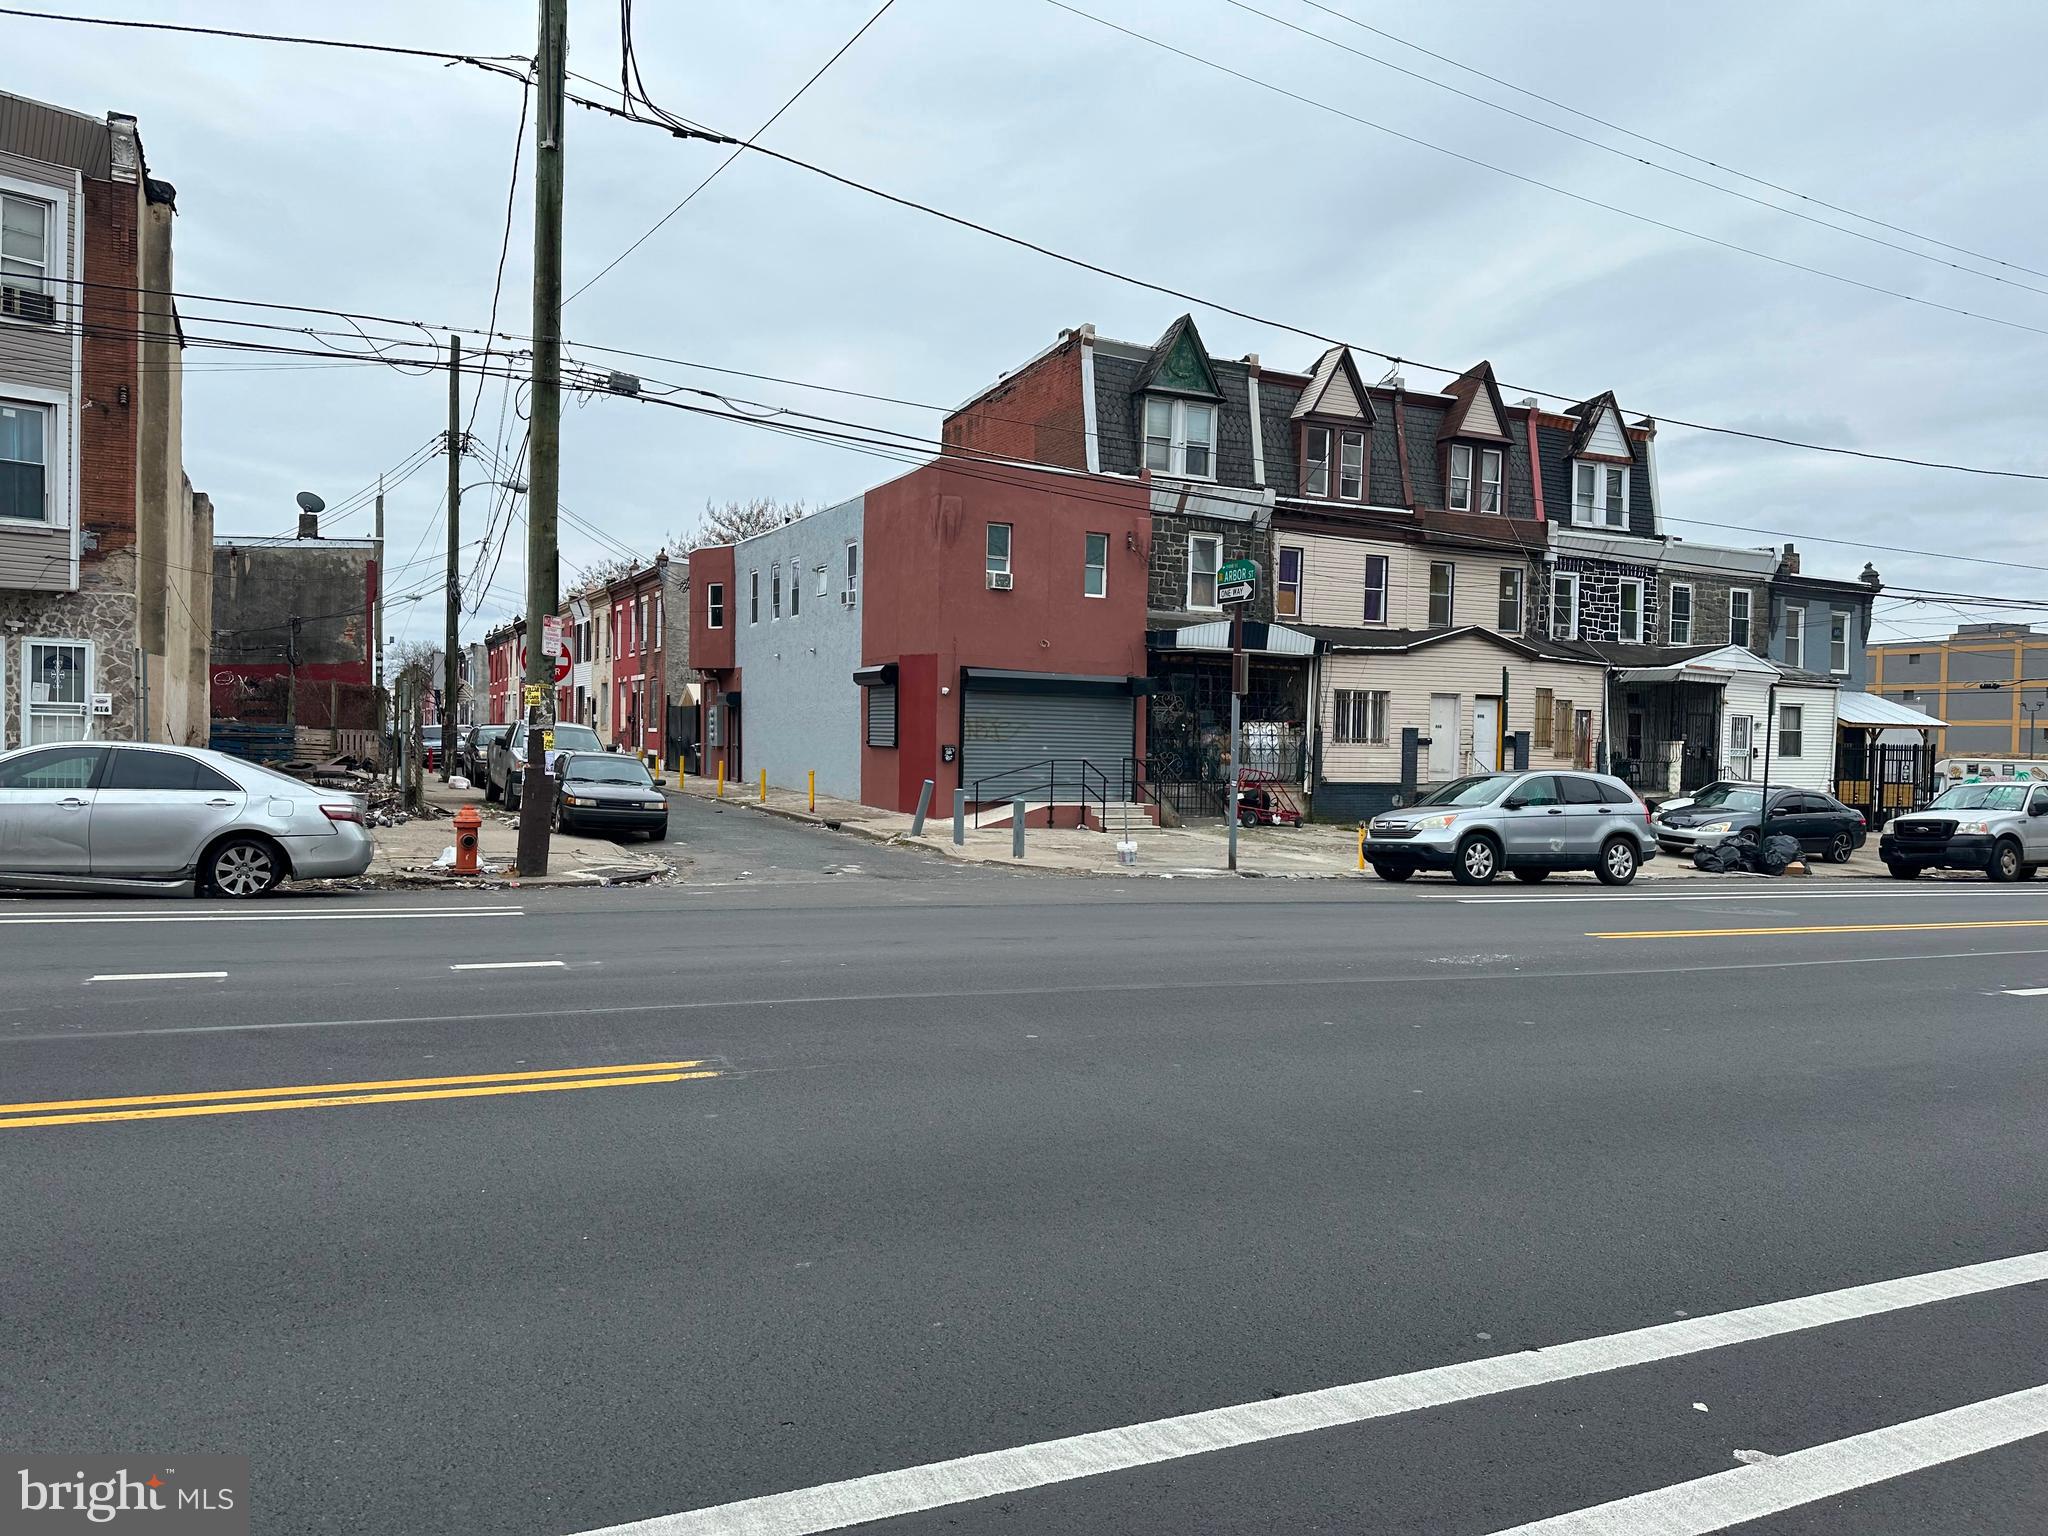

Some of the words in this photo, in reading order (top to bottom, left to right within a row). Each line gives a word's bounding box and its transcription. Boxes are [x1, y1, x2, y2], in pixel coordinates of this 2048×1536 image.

[1224, 567, 1246, 582] ARBOR
[1248, 570, 1254, 578] ST
[1221, 589, 1231, 597] ONE
[1232, 587, 1243, 595] WAY
